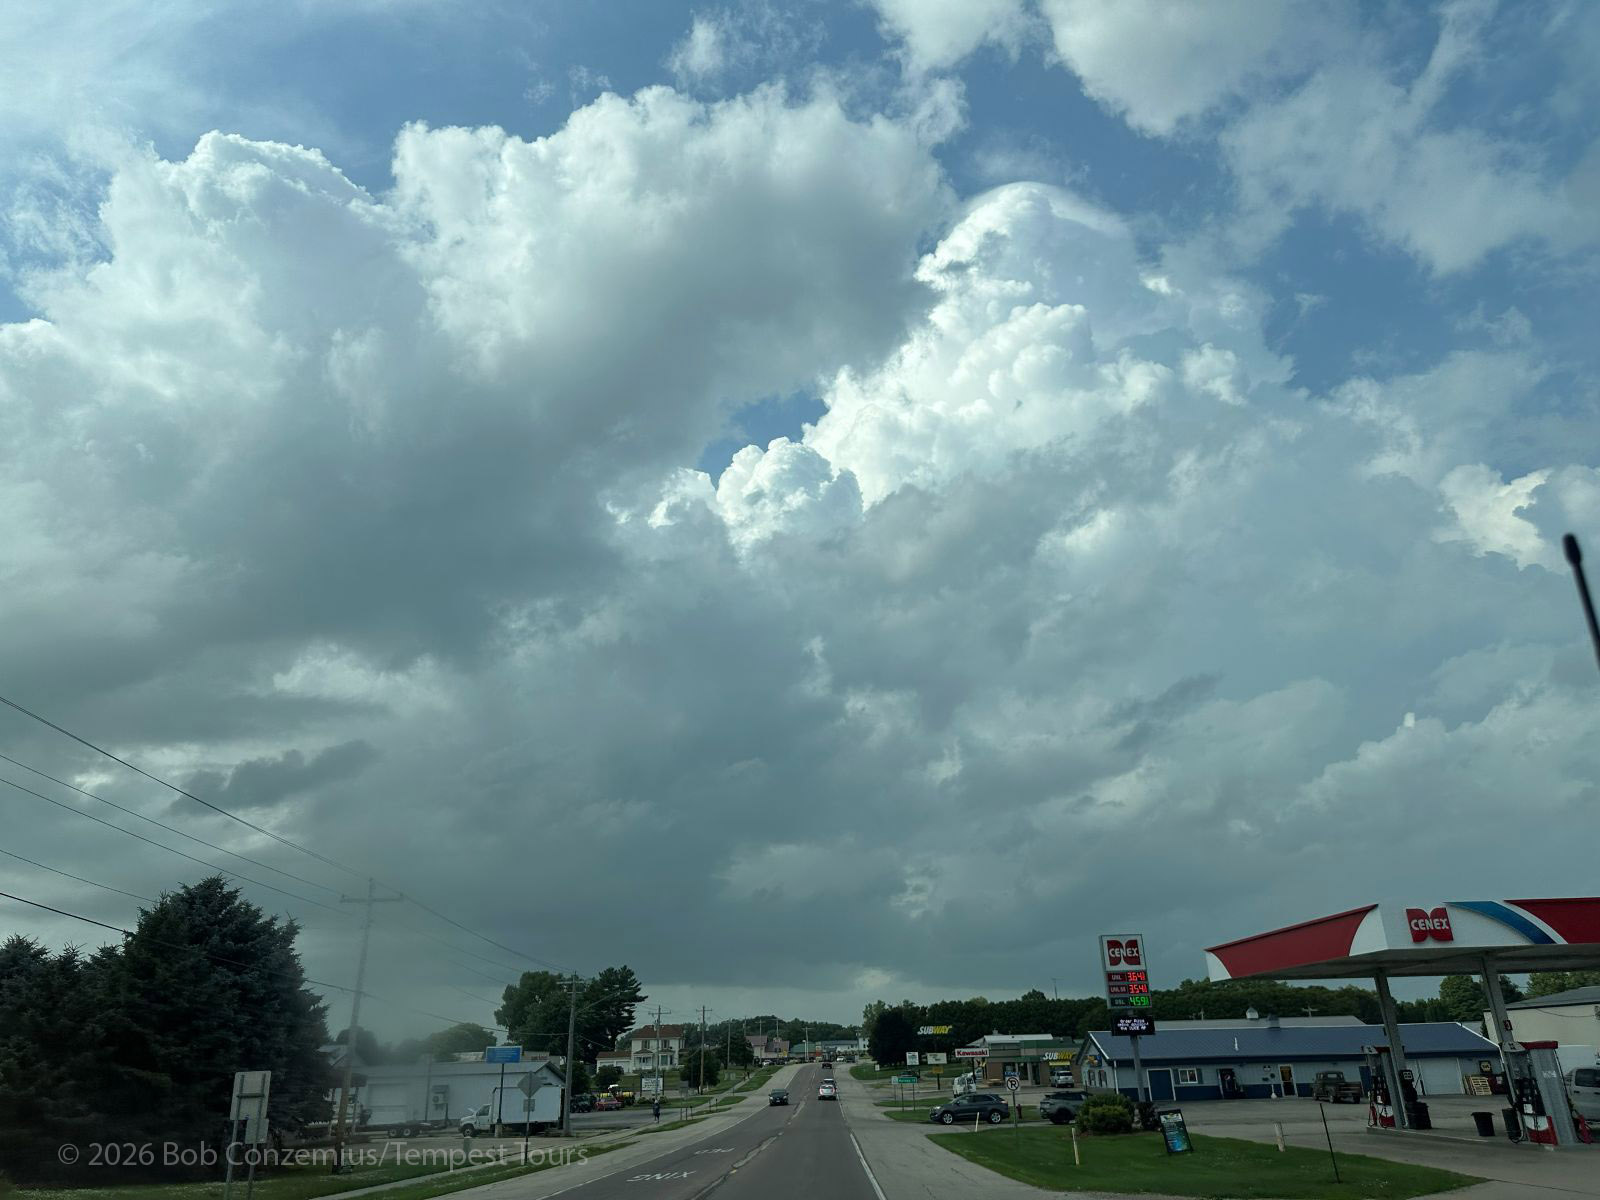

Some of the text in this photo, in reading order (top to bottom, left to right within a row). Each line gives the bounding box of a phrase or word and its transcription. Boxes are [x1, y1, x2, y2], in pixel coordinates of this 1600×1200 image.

[1411, 918, 1449, 930] CENEX
[1109, 947, 1139, 957] CENEX
[917, 1025, 952, 1035] SUBWAY
[1042, 1051, 1076, 1060] SUBWAY
[625, 1170, 697, 1182] XING
